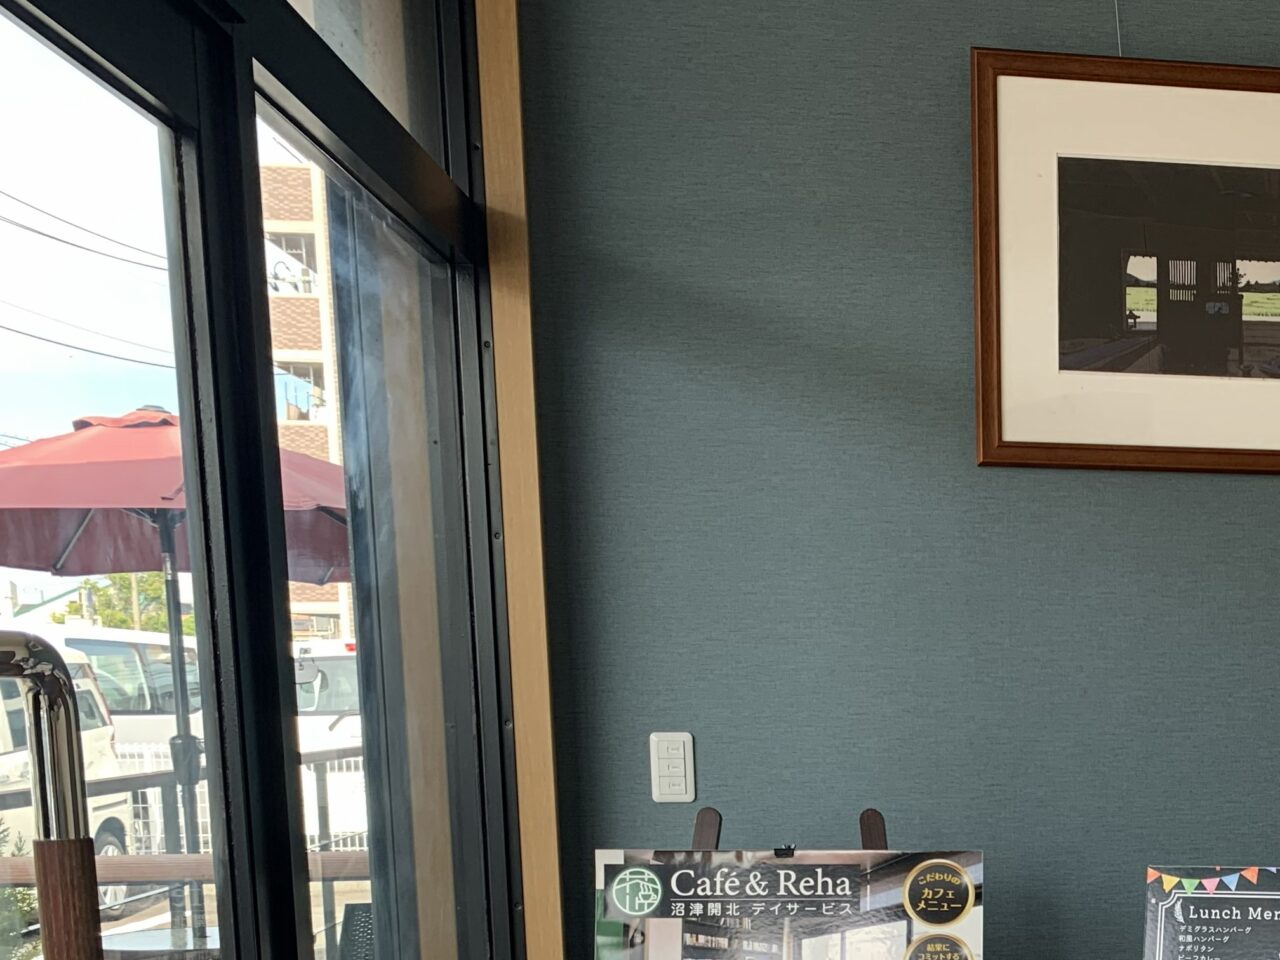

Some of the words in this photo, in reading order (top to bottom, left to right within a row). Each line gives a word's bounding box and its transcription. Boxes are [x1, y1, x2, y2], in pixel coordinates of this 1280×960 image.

[670, 868, 740, 896] Café
[745, 871, 769, 896] &
[776, 867, 852, 896] Reha
[918, 872, 960, 885] こだわりの
[921, 887, 955, 899] カフェ
[671, 902, 740, 916] 沼津開北
[751, 902, 852, 916] デイサービス
[916, 900, 962, 911] メニュー
[1189, 905, 1241, 919] Lunch
[1179, 925, 1252, 934] デミグラスハンバーグ
[1178, 934, 1229, 943] 和風ハンバーグ
[918, 952, 960, 960] コミットする
